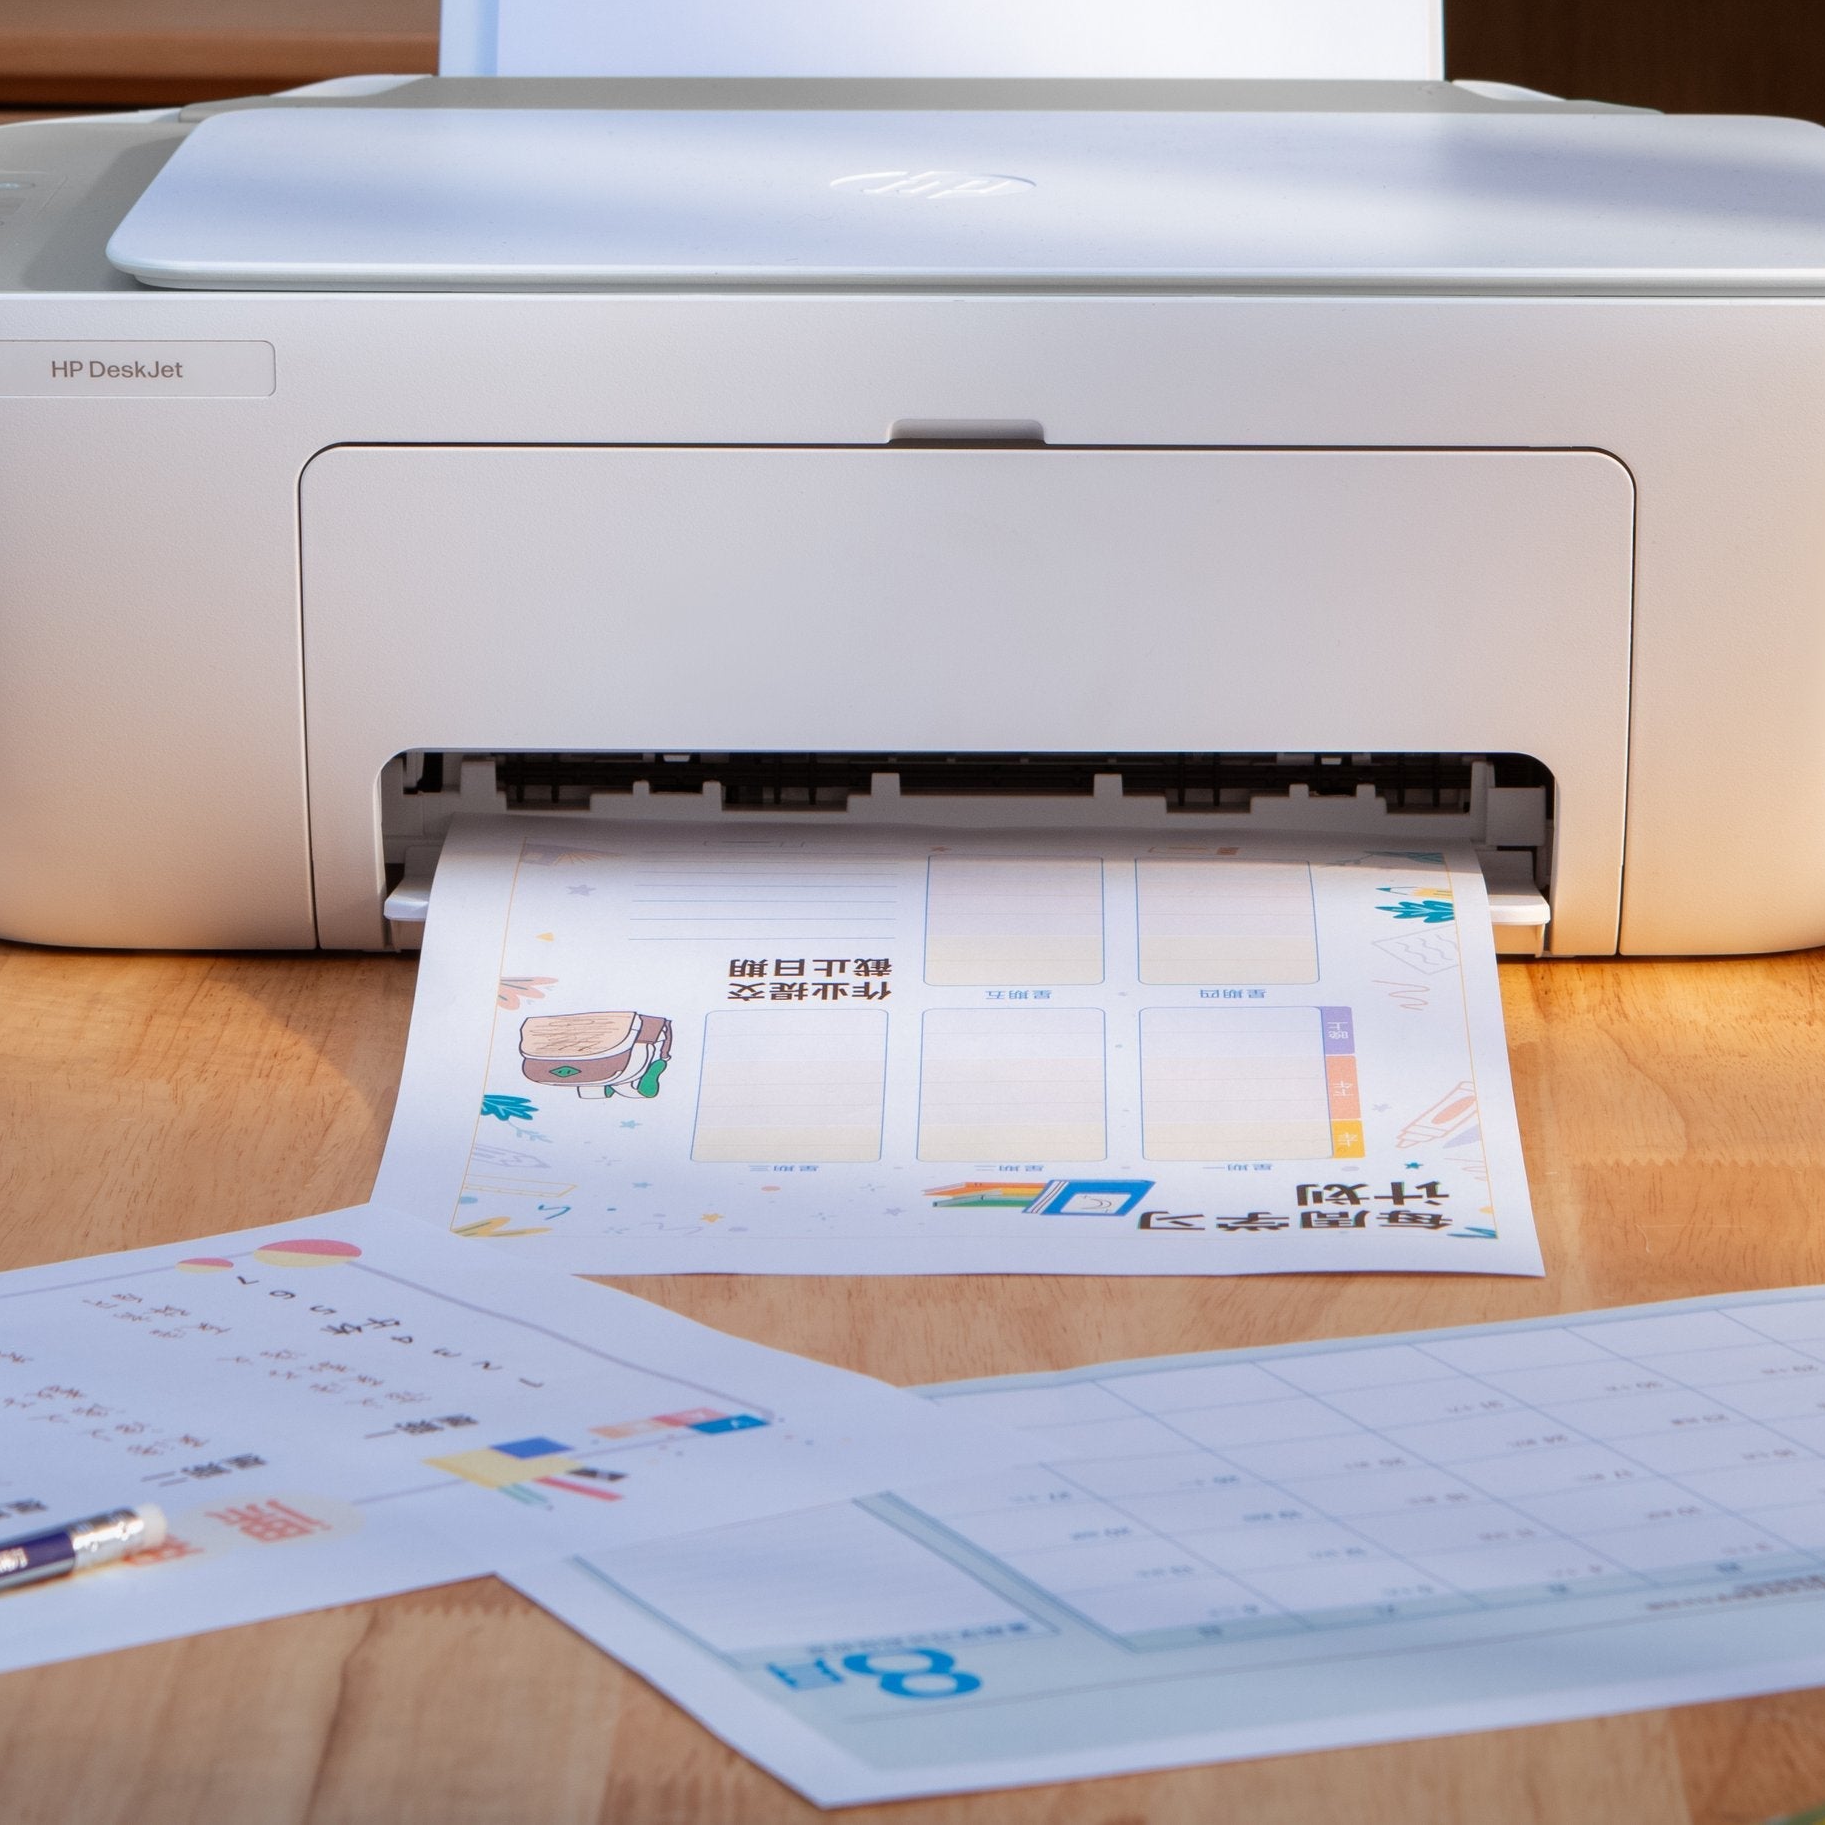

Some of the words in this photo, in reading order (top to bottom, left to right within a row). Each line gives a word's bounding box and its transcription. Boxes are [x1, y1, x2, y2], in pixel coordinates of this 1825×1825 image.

[51, 361, 83, 379] HP
[88, 360, 184, 380] DeskJet
[727, 958, 892, 978] 截止日期
[726, 981, 892, 1002] 作业提交
[984, 989, 1052, 1000] 星期五
[1198, 989, 1267, 999] 星期四
[1296, 1181, 1450, 1207] 计划
[1137, 1210, 1453, 1232] 每周学习
[237, 1276, 258, 1285] 7
[269, 1291, 296, 1299] 6
[310, 1306, 336, 1314] 5
[391, 1336, 413, 1344] 4
[433, 1349, 460, 1357] 3
[473, 1359, 504, 1372] 2
[519, 1378, 544, 1388] 1
